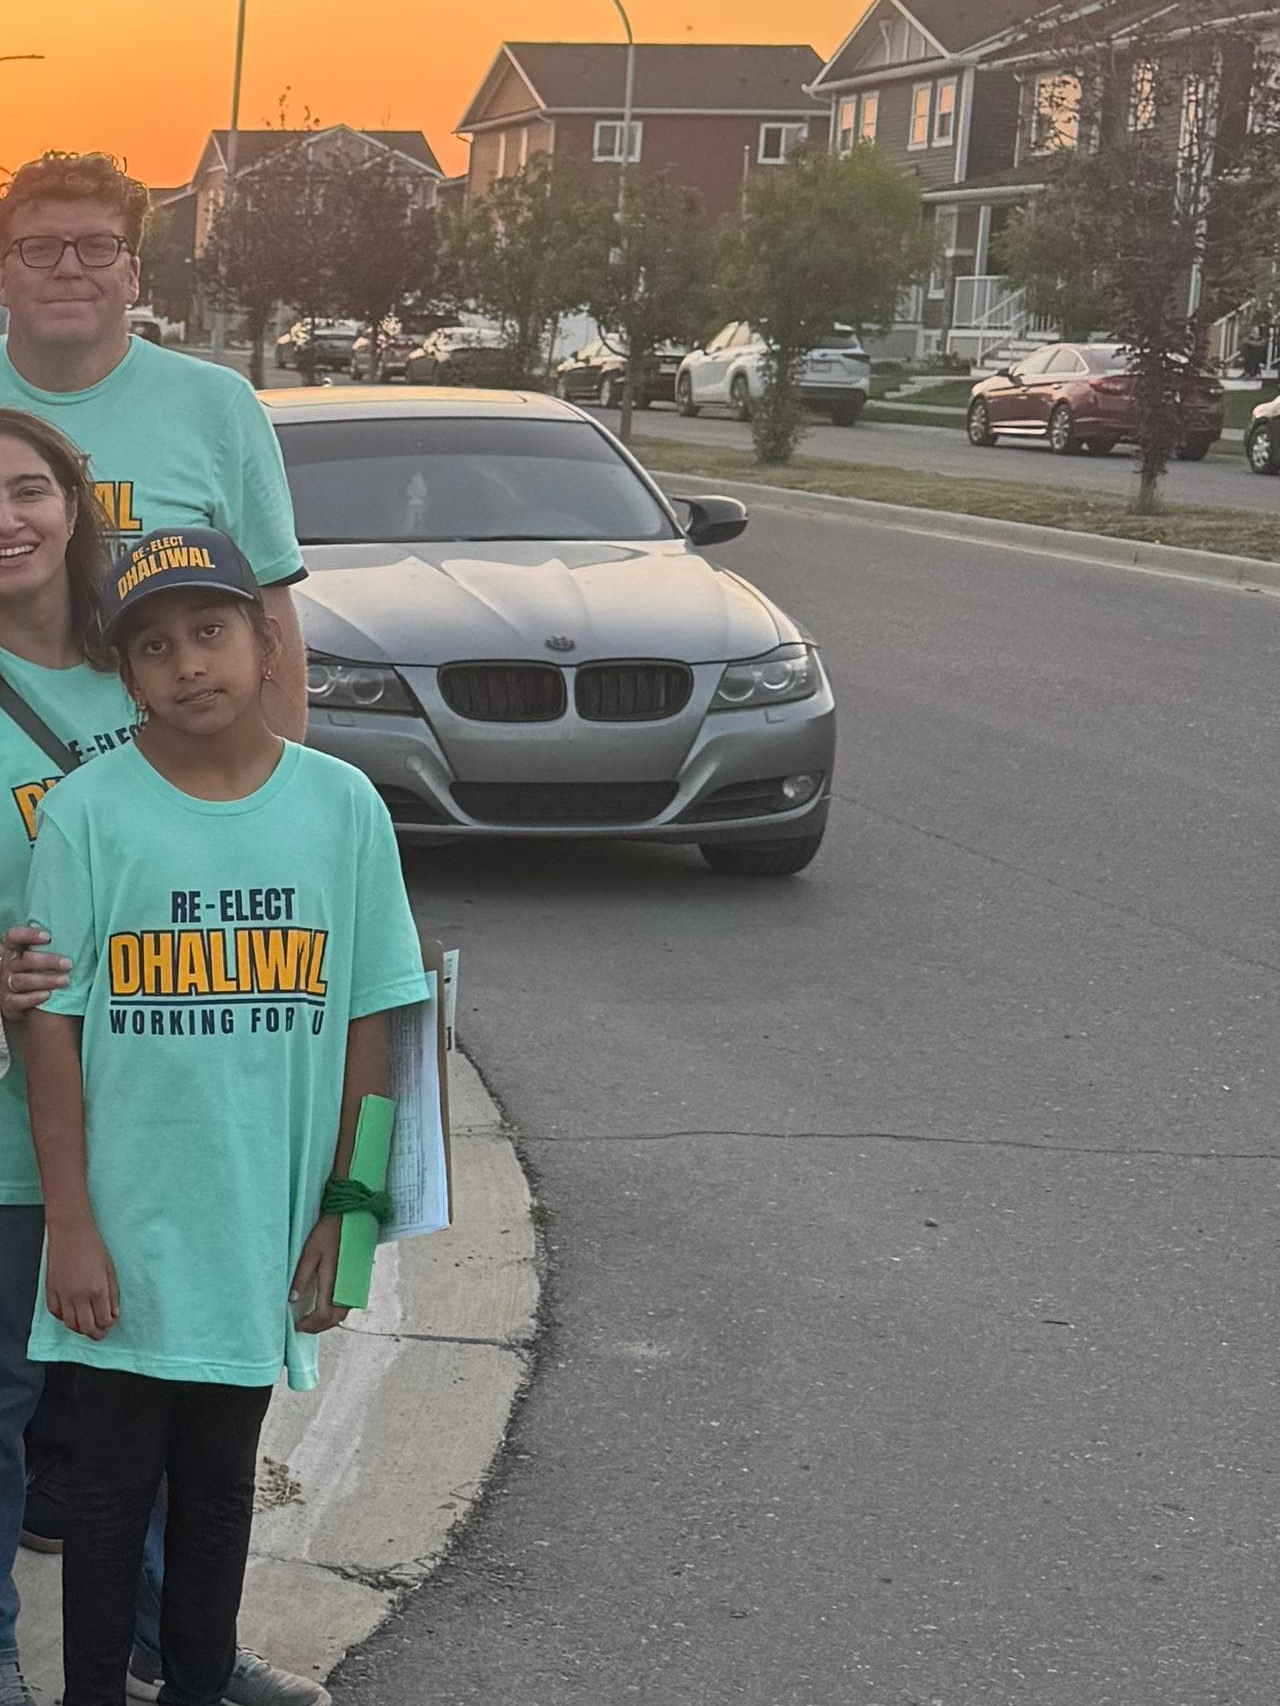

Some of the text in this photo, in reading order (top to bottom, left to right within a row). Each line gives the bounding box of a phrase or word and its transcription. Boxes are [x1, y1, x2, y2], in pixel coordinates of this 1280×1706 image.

[117, 546, 217, 602] DHALIWAL
[171, 888, 296, 923] RE-ELECT
[110, 1008, 234, 1035] WORKING
